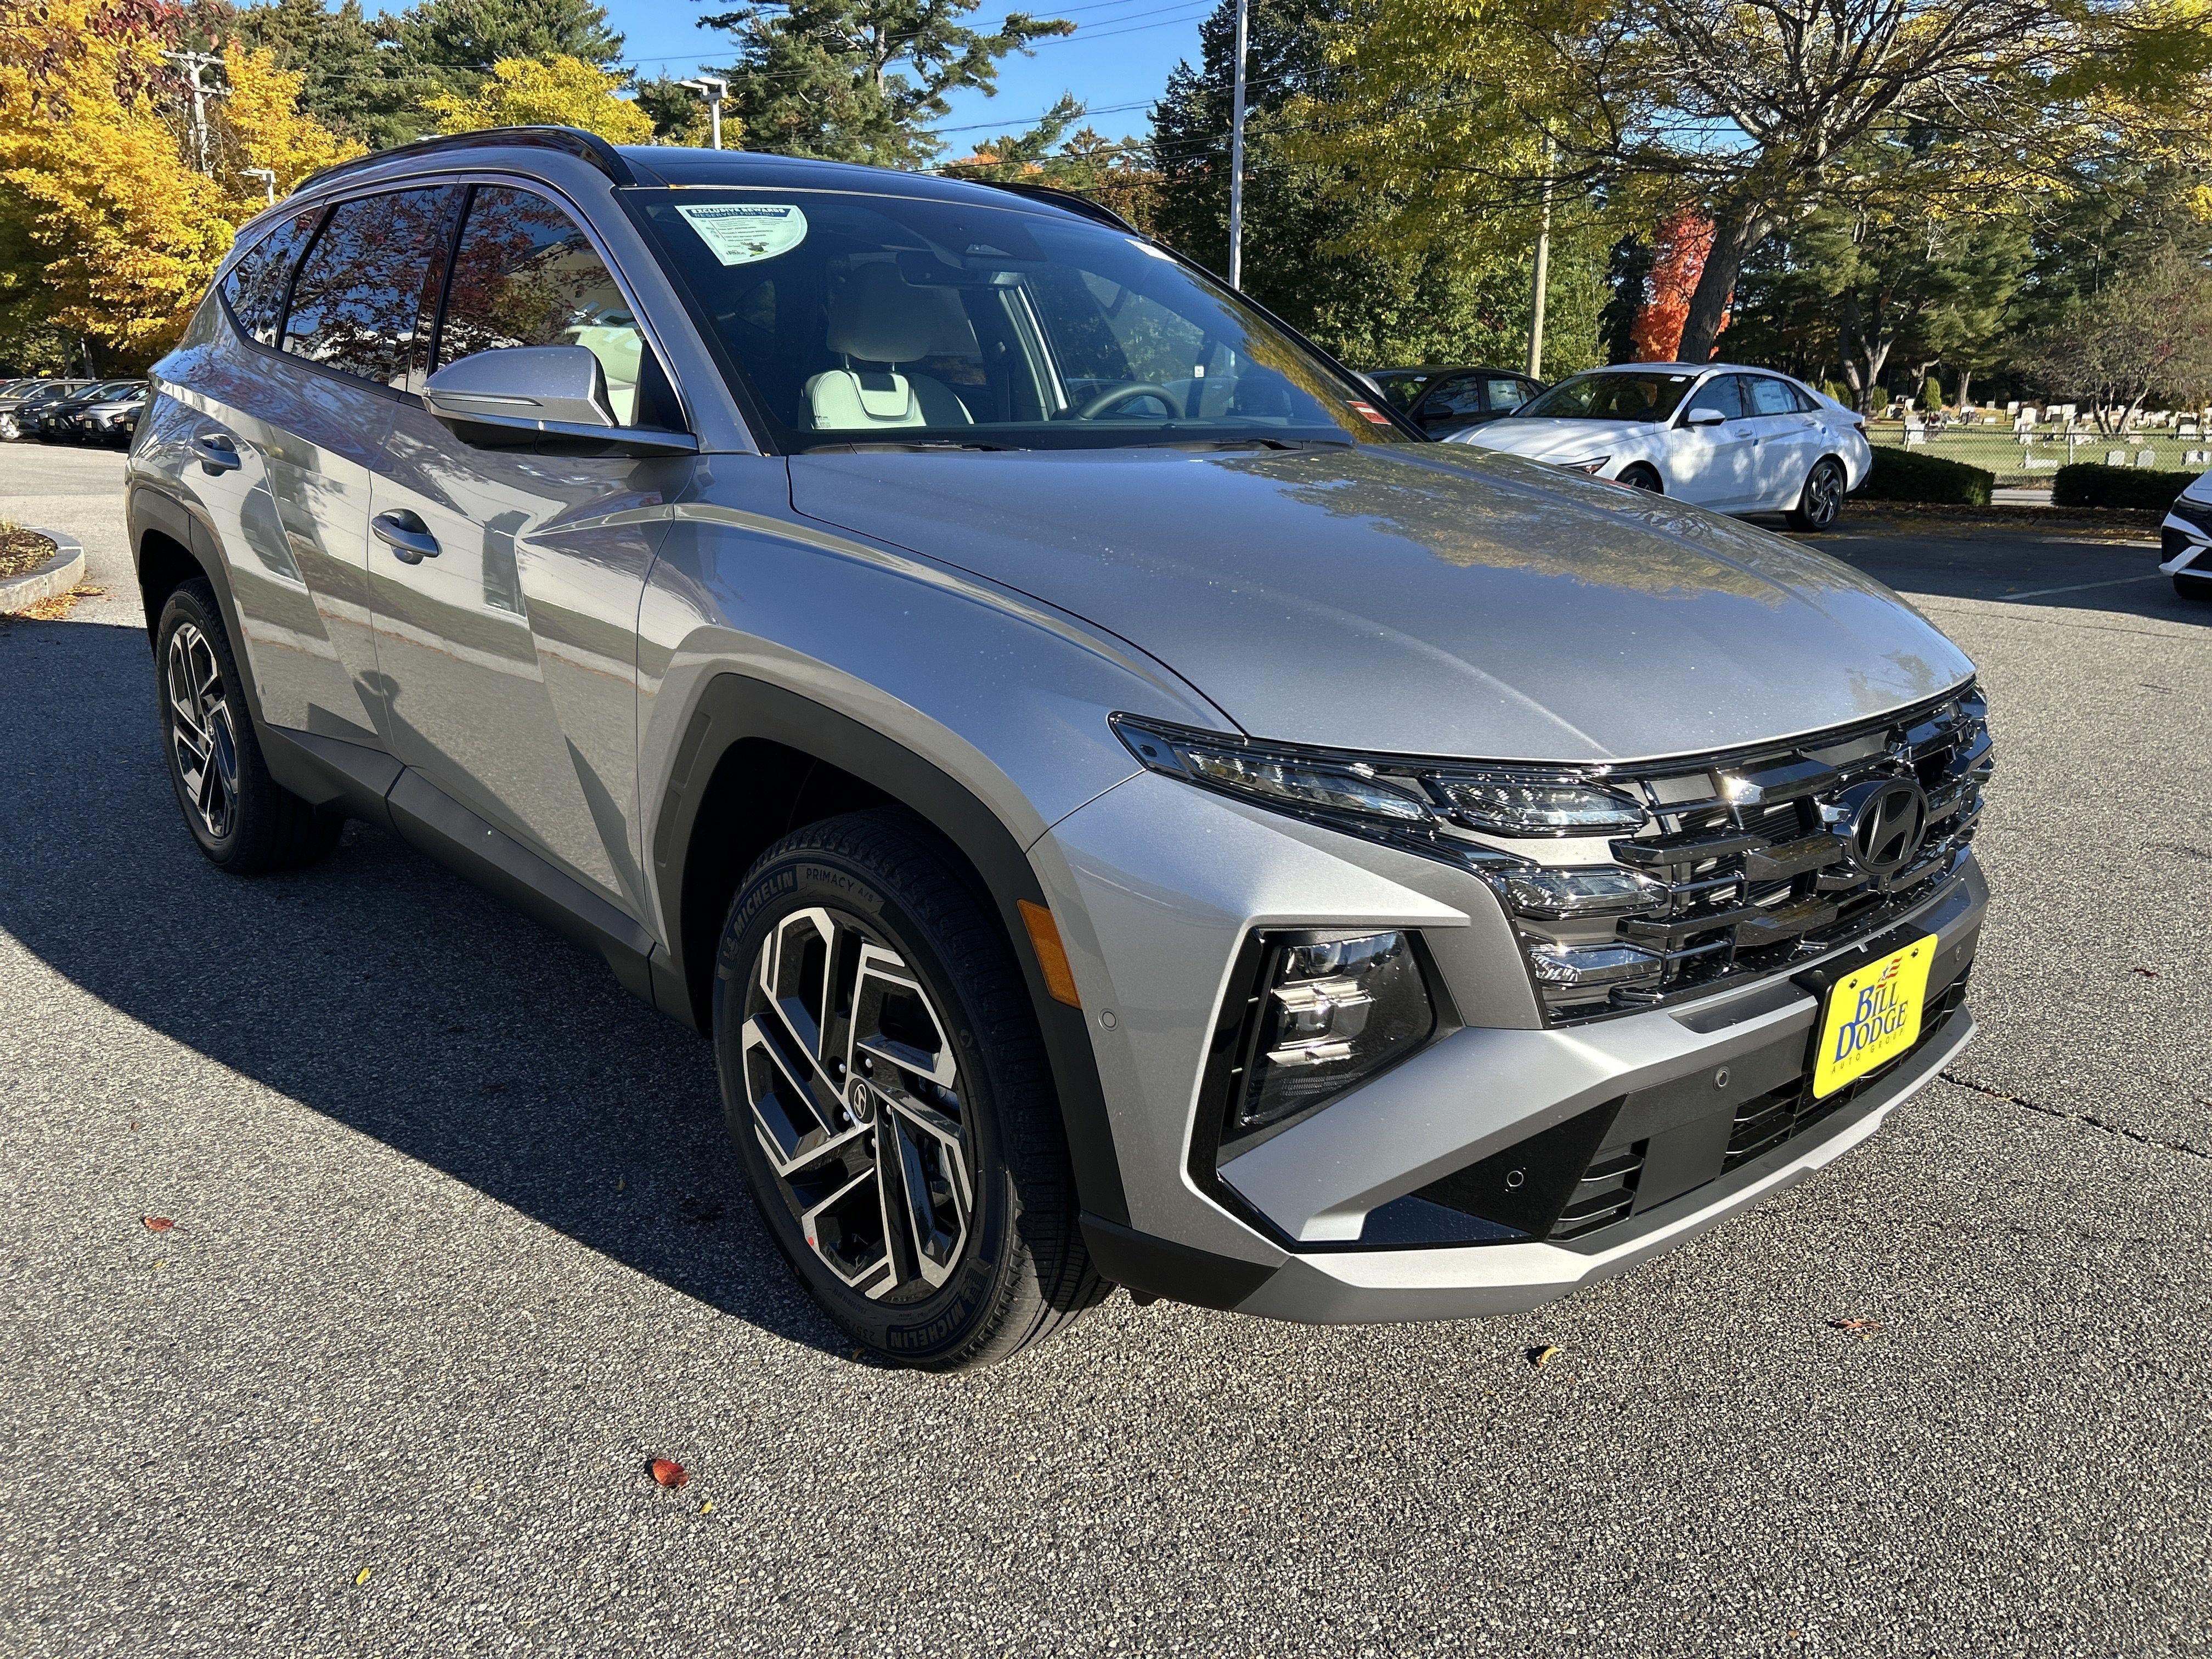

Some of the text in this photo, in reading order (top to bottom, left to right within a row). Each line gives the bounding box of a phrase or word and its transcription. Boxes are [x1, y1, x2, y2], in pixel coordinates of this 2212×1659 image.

[733, 870, 794, 938] MICHELIN
[806, 867, 855, 891] PRIMACY
[1854, 981, 1899, 1025] BILL
[1831, 1028, 1905, 1074] AUTO GROUP
[1833, 1000, 1909, 1064] DODGE
[890, 1299, 966, 1348] MICHELIN
